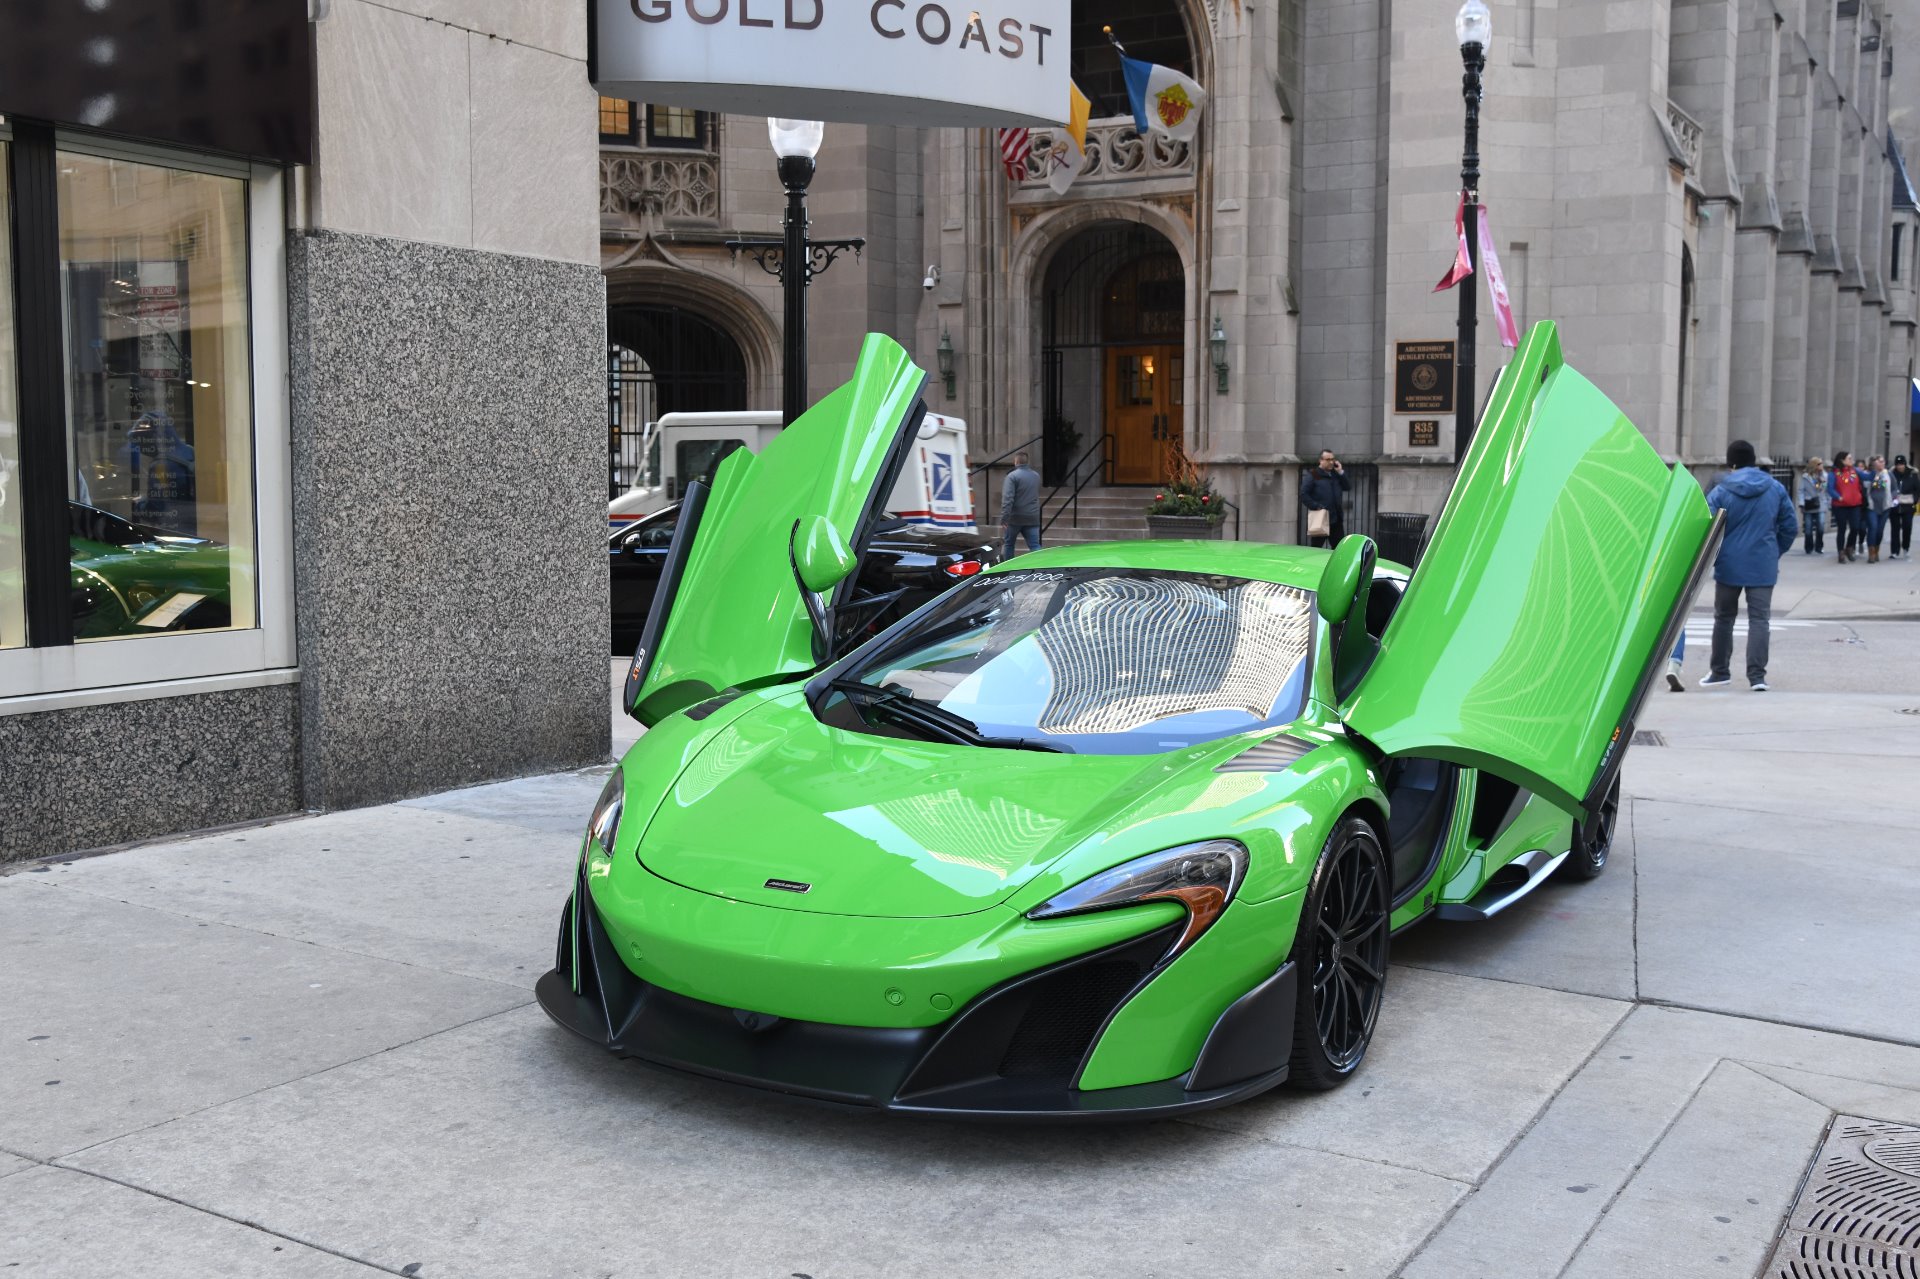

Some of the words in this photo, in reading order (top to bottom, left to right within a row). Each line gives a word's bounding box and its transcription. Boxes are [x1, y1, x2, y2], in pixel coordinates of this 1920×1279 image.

[631, 0, 824, 30] GOLD
[870, 0, 1052, 66] COAST
[1414, 422, 1433, 433] 835
[632, 647, 646, 681] 675LT
[1600, 726, 1620, 767] 675LT
